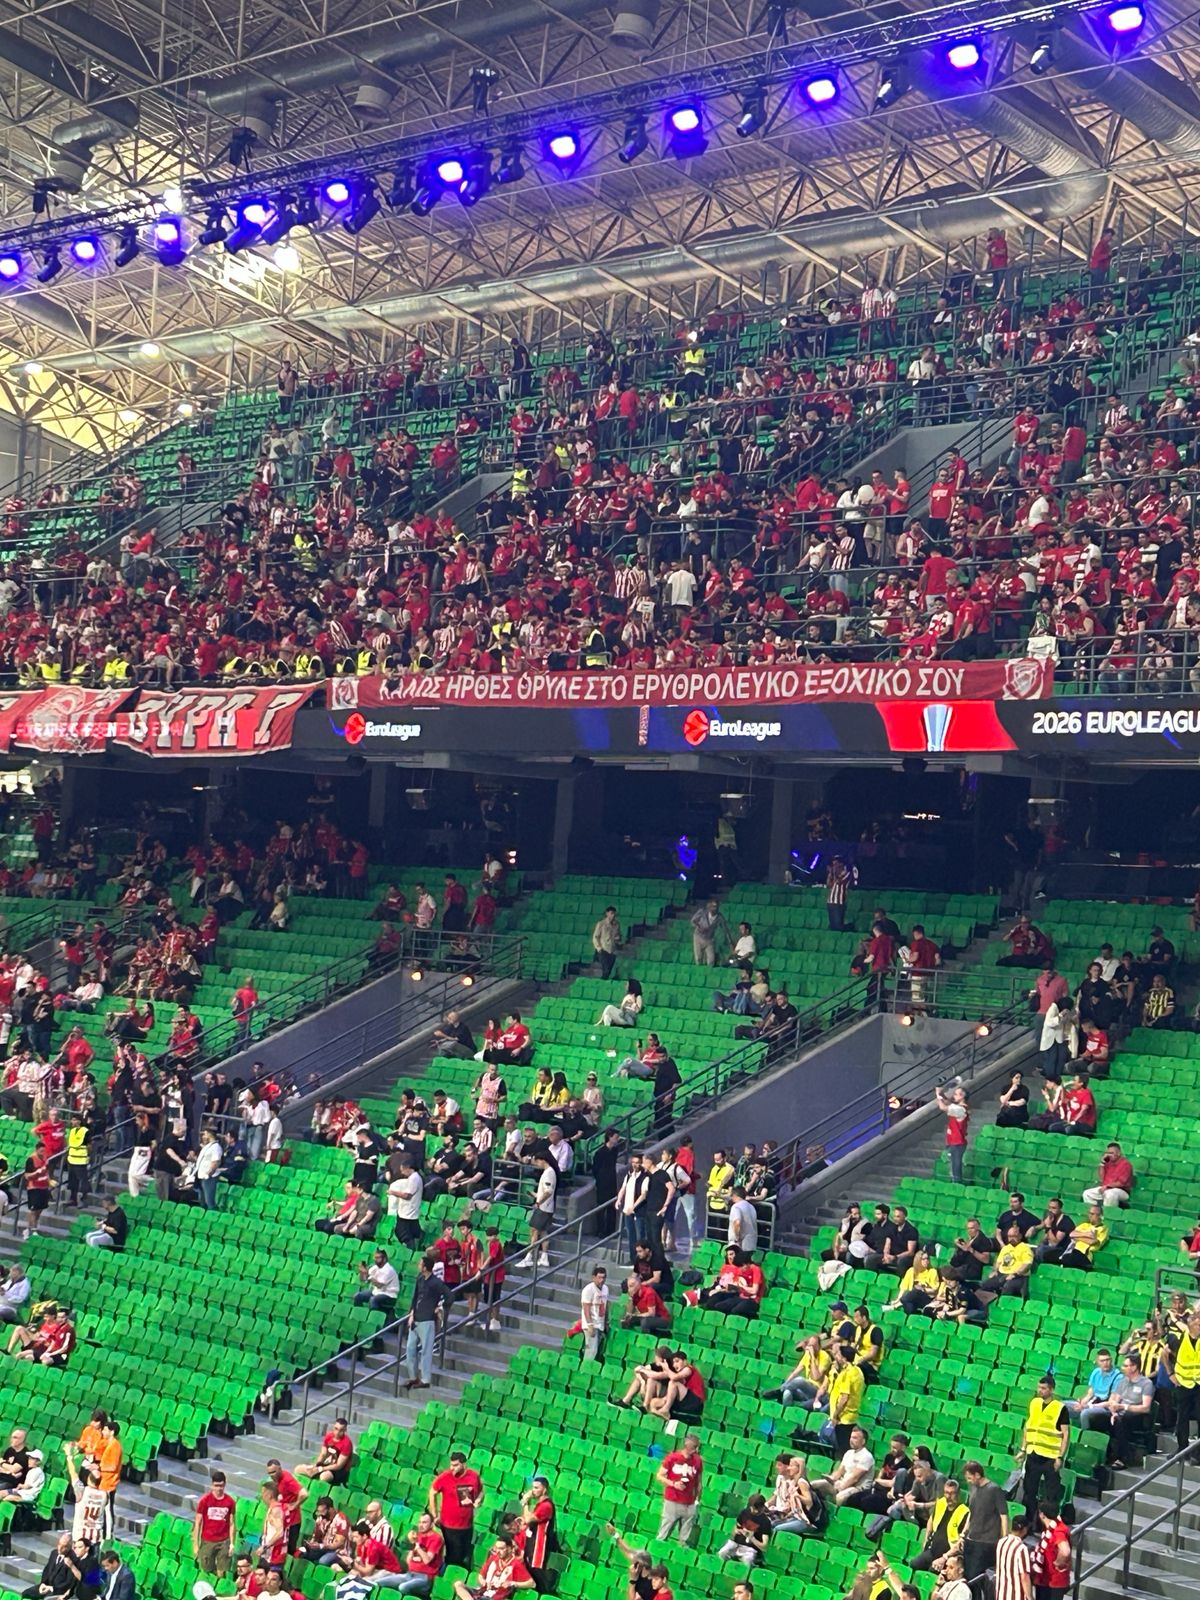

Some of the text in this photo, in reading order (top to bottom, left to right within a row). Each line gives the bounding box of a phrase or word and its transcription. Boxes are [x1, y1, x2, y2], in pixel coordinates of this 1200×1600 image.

[446, 674, 513, 700] ΗΡΘΕΣ
[517, 674, 583, 700] ΘΡΥΛΕ
[584, 675, 627, 701] ΣΤΟ
[632, 670, 799, 701] ΕΡΥΘΡΟΛΕΥΚΟ
[804, 667, 911, 697] ΕΞΟΧΙΚΟ
[916, 667, 965, 697] ΣΟΥ
[710, 720, 781, 741] EuroLeague
[1032, 711, 1082, 734] 2026
